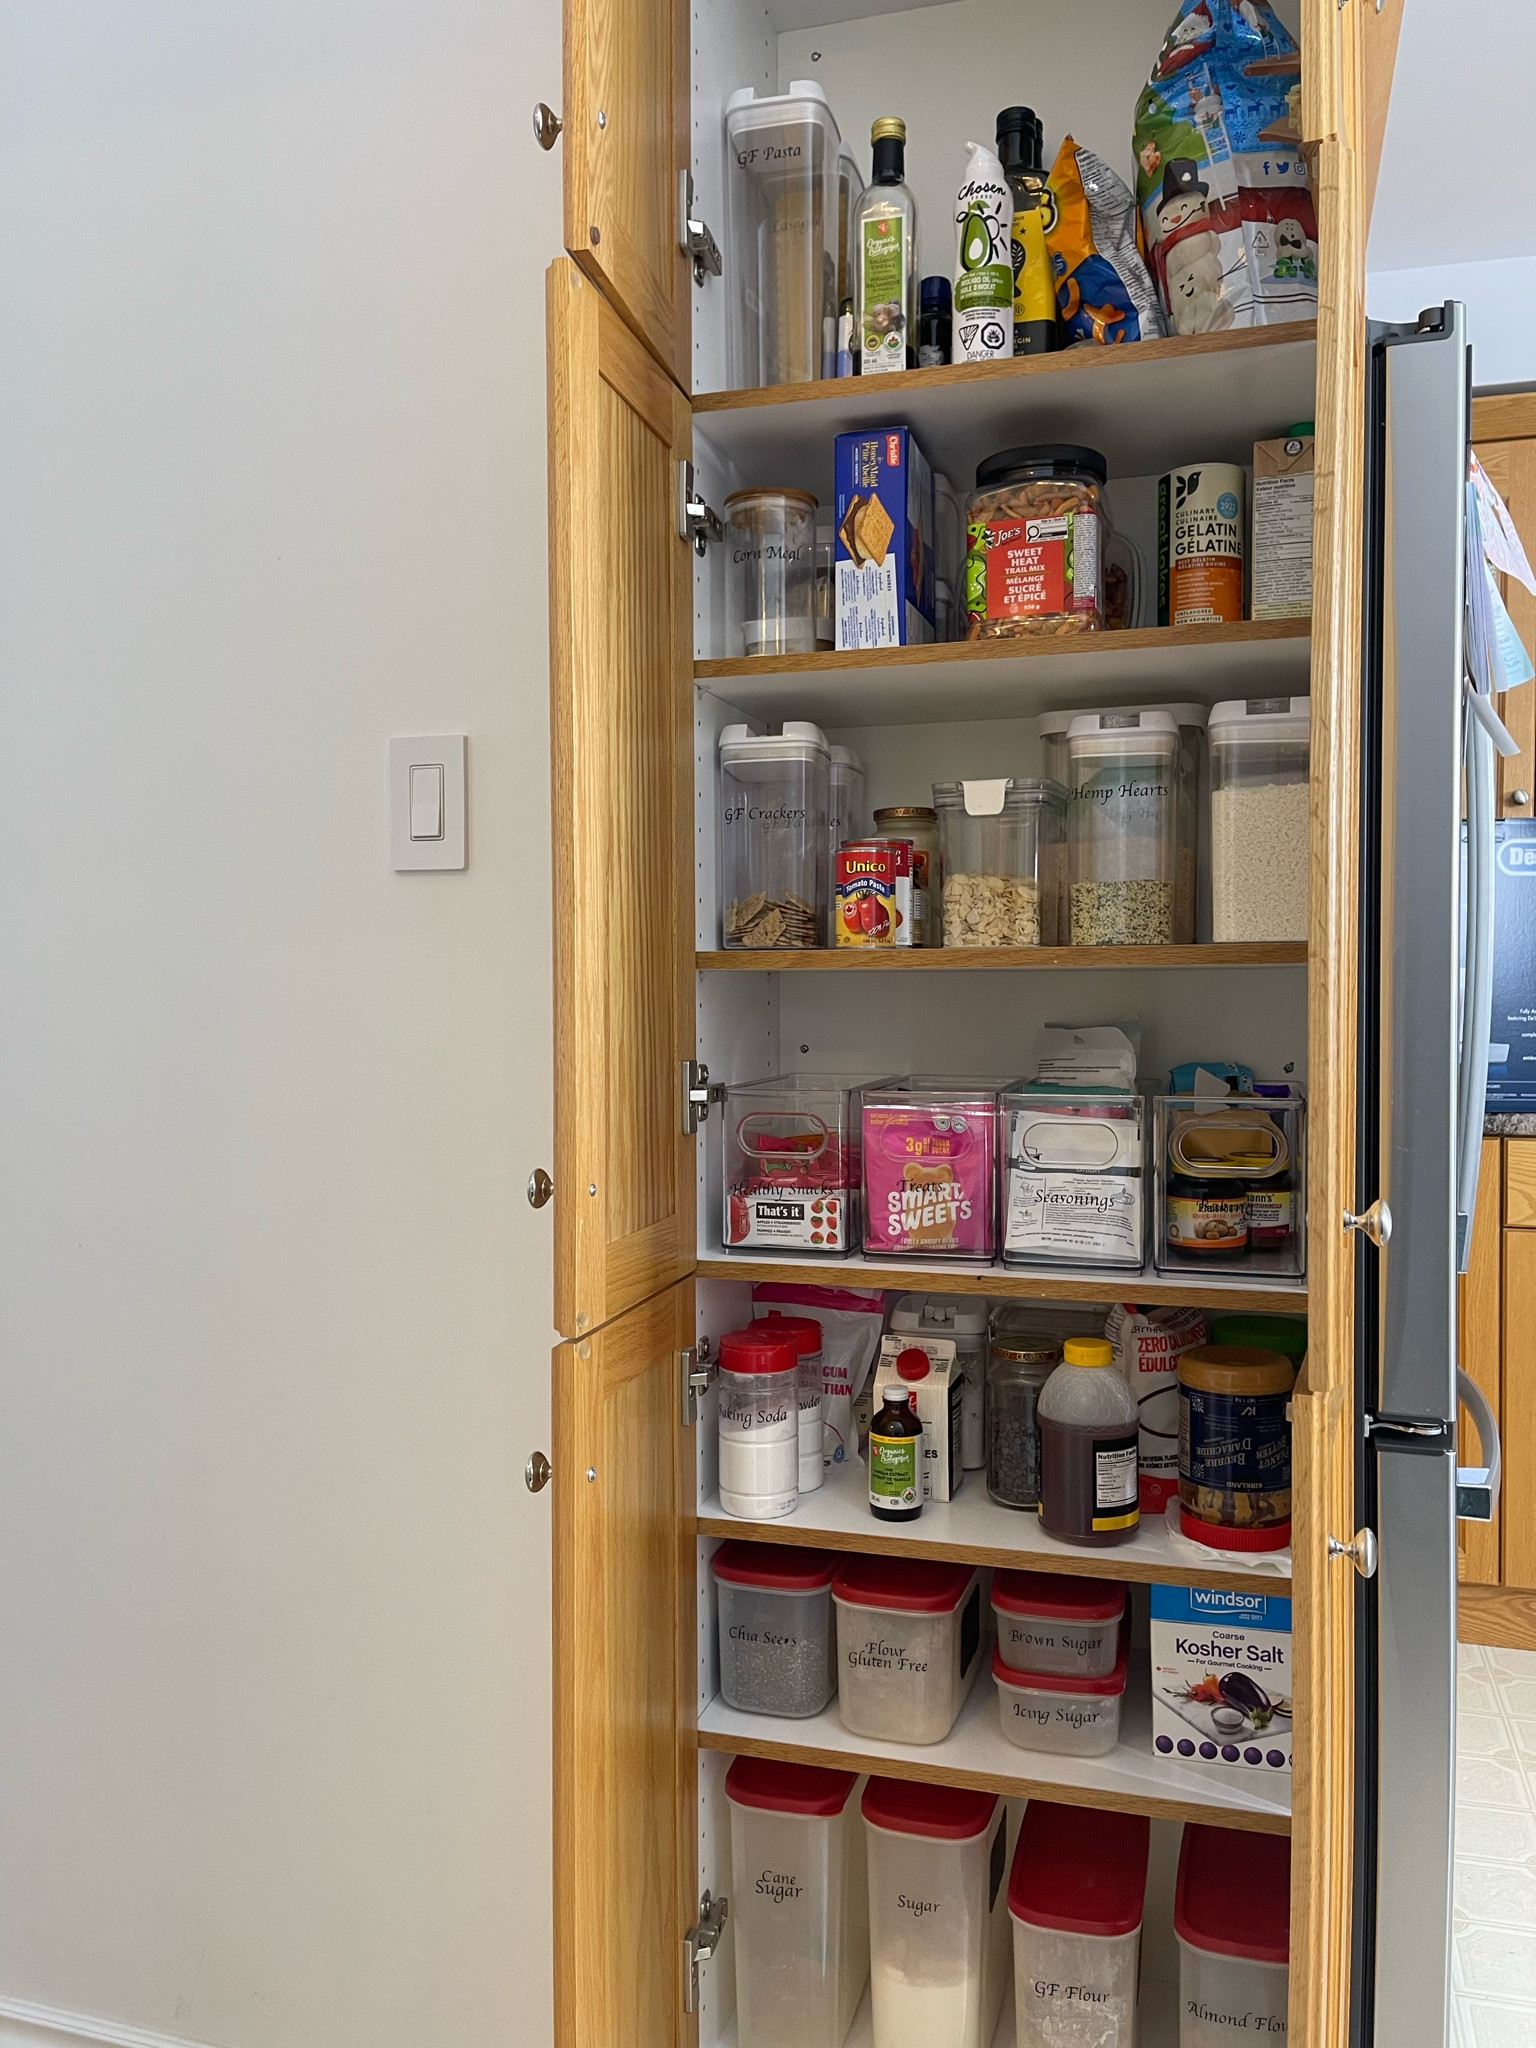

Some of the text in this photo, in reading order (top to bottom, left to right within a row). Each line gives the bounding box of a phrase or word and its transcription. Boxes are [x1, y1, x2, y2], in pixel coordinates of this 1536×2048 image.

[737, 146, 801, 169] GF Pasta
[958, 181, 1006, 200] Chosen
[967, 350, 995, 360] DANGER
[889, 436, 898, 465] Christie
[1175, 508, 1215, 518] CULINARY
[1175, 515, 1218, 526] CULINAIRE
[1175, 523, 1237, 539] GELATIN
[733, 545, 802, 564] Corn Meal
[1007, 547, 1043, 559] SWEET
[1175, 538, 1242, 555] GÉLATINE
[1005, 564, 1046, 575] TRAIL MIX
[1011, 556, 1040, 567] HEAT
[1005, 574, 1045, 585] MÉLANGE
[1008, 581, 1042, 595] SUCRÉ
[1003, 589, 1047, 604] ET ÉPICÉ
[1072, 780, 1168, 806] Hemp Hearts
[724, 803, 806, 825] GF Crackers
[846, 860, 886, 874] Unico
[846, 879, 887, 894] Tomato Paste
[905, 1136, 922, 1156] 3g
[730, 1180, 834, 1201] Healthy Snacks
[896, 1178, 943, 1193] Treats
[888, 1182, 963, 1213] SMART
[1034, 1189, 1115, 1213] Seasonings
[757, 1205, 801, 1217] That's it
[888, 1200, 972, 1236] SWEETS
[1137, 1336, 1168, 1353] ZERO
[822, 1365, 848, 1379] GUM
[757, 1405, 787, 1424] Soda
[1097, 1451, 1125, 1460] Nutrition
[1204, 1453, 1246, 1467] BEURRE
[1194, 1589, 1263, 1609] windsor
[729, 1625, 797, 1647] Chia Sees
[1008, 1629, 1104, 1656] Brown Sugar
[1212, 1630, 1245, 1641] Coarse
[865, 1640, 906, 1657] Flour
[1175, 1638, 1284, 1664] Kosher Salt
[848, 1651, 928, 1672] Gluten Free
[1207, 1659, 1236, 1669] Gourmet
[1236, 1661, 1263, 1672] Cooking
[1013, 1703, 1100, 1729] Icing Sugar
[762, 1870, 797, 1886] Cane
[755, 1879, 803, 1903] Sugar
[896, 1894, 941, 1917] Sugar
[1034, 1981, 1111, 2004] GF Flour
[1187, 2000, 1289, 2033] Almond Flou
